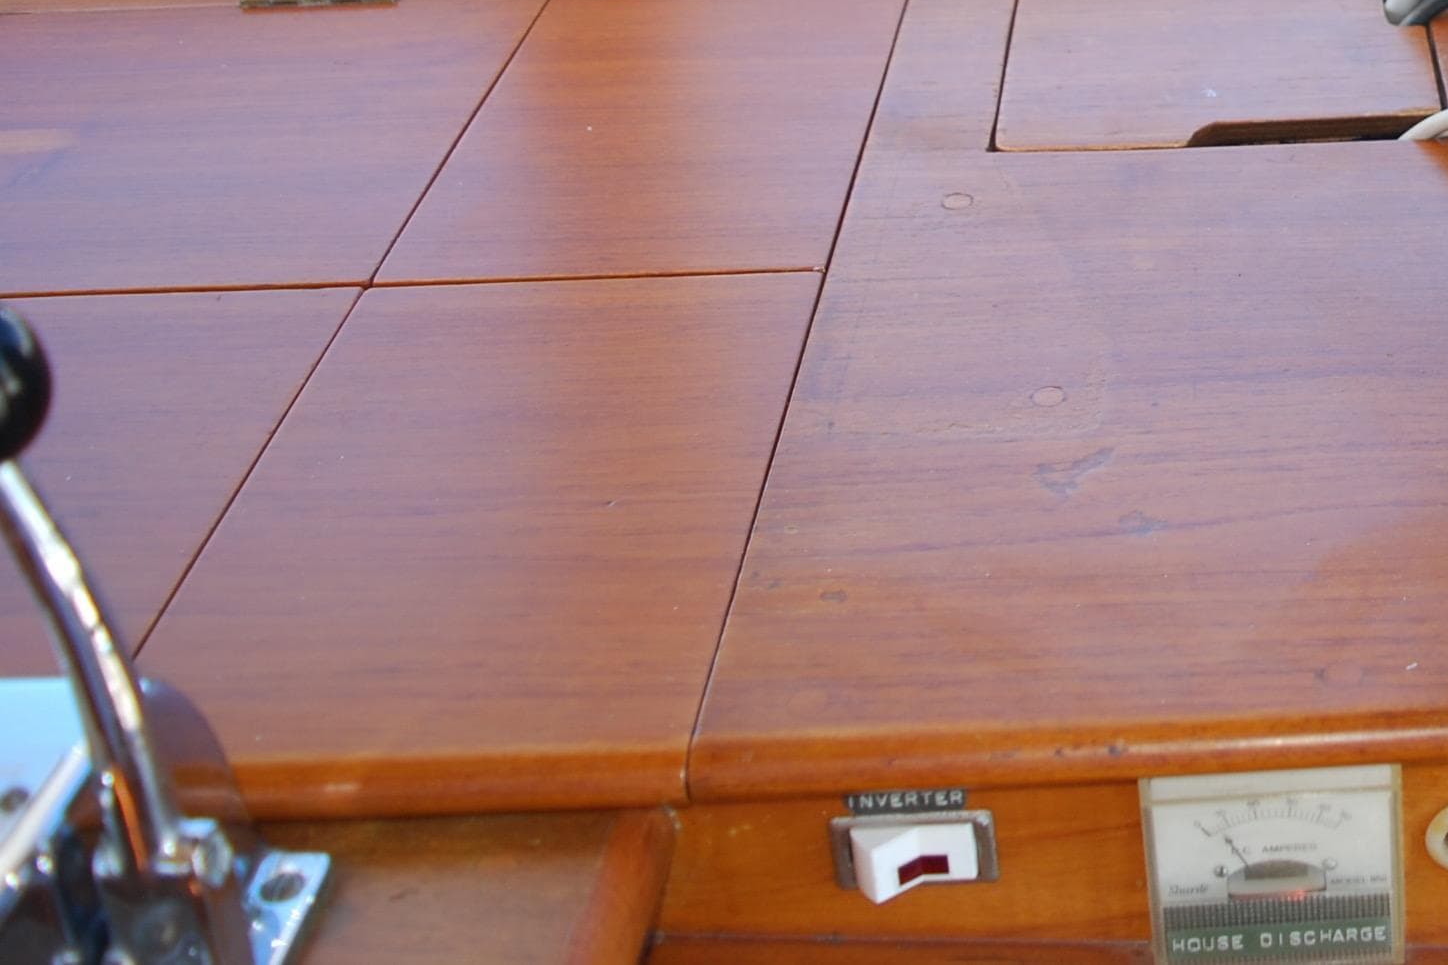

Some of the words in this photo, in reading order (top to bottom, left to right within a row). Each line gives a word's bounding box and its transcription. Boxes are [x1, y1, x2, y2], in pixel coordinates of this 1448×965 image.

[848, 790, 962, 808] INVERTER
[1172, 935, 1244, 952] HOUSE
[1260, 926, 1387, 947] DISCHARGE
